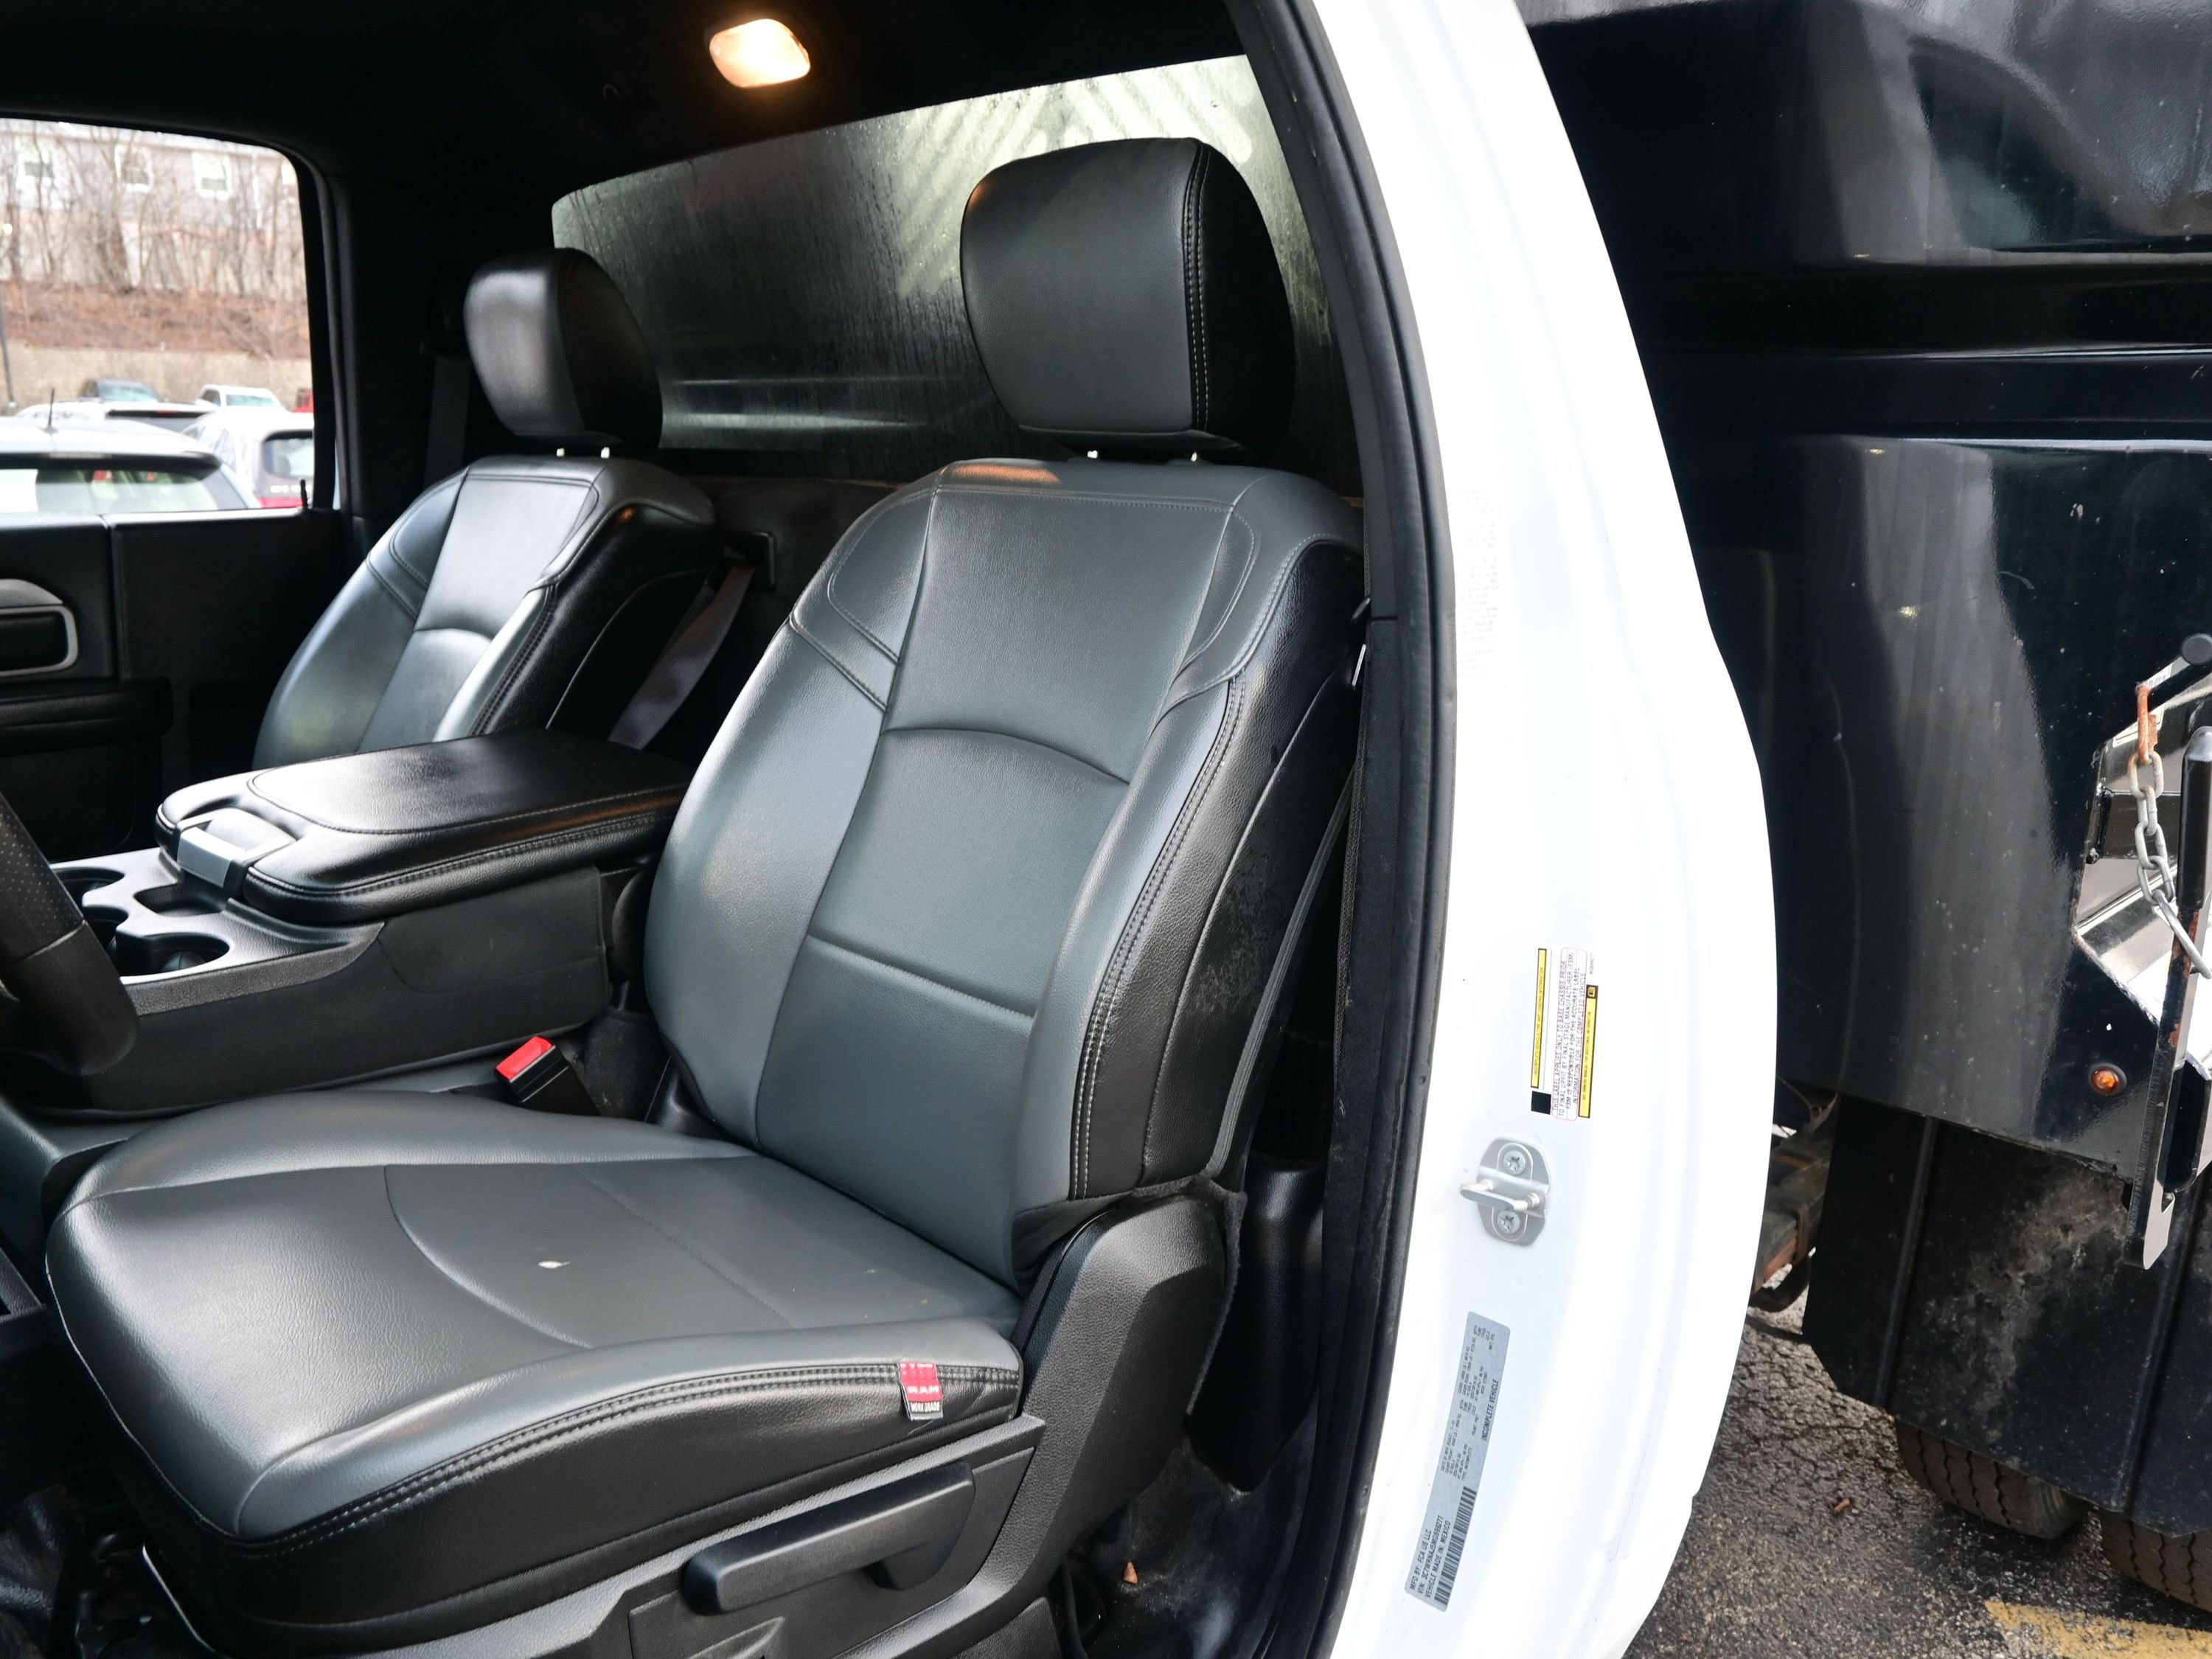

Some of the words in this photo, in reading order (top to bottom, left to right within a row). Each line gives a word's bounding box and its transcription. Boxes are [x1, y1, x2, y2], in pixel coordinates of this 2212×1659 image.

[1558, 980, 1566, 1006] CHASSIS
[1564, 970, 1573, 1020] MANUFACTURER
[1576, 998, 1585, 1034] COMPLETED
[1557, 1023, 1563, 1032] TO
[1567, 1047, 1575, 1088] RESPONSIBLE
[1571, 987, 1579, 1018] ACCURATE
[1561, 1060, 1568, 1069] BY
[1572, 1063, 1581, 1105] INFORMATION
[1559, 1108, 1565, 1116] TO
[908, 1385, 939, 1394] RAM
[1487, 1377, 1500, 1405] VEHICLE
[1480, 1403, 1495, 1442] INCOMPLETE
[1423, 1527, 1432, 1542] LLC
[1439, 1519, 1451, 1545] MEXICO
[1420, 1539, 1429, 1551] US
[1437, 1543, 1445, 1555] IN:
[1416, 1548, 1426, 1565] FCA
[1432, 1553, 1442, 1574] MADE
[1409, 1574, 1419, 1591] MFD
[1416, 1580, 1425, 1596] VIN:
[1424, 1571, 1437, 1601] VEHICLE
